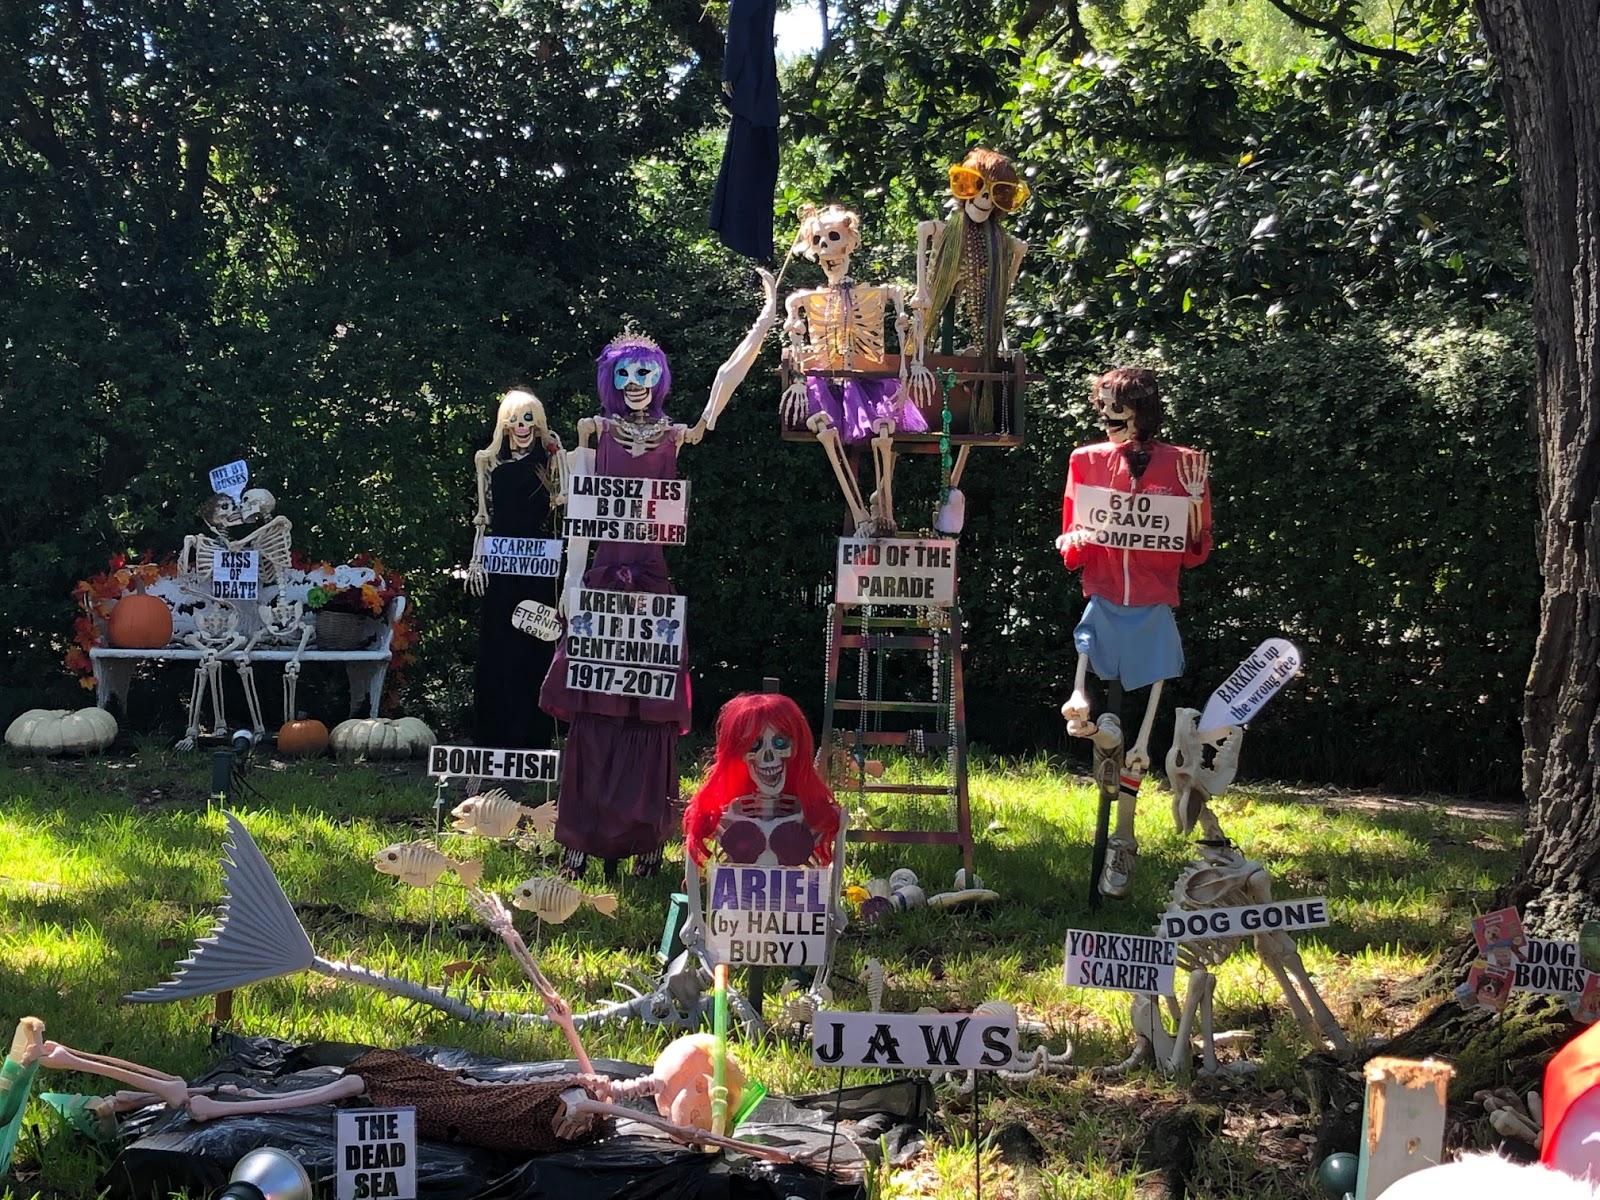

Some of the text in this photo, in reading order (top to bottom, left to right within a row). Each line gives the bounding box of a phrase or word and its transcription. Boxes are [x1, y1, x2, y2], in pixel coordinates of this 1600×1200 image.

[211, 461, 244, 480] HIT BY
[573, 476, 682, 501] LAISSEZ LES
[596, 497, 656, 519] BONE
[1109, 494, 1151, 513] 610
[563, 518, 686, 543] TEMPS ROULER
[1089, 507, 1170, 533] (GRAVE)
[221, 551, 251, 569] KISS
[490, 538, 547, 557] SCARRIE
[842, 544, 951, 568] END OF THE
[229, 568, 242, 581] OF
[480, 554, 560, 576] NDERWOOD
[213, 580, 257, 599] DEATH
[857, 575, 935, 599] PARADE
[536, 604, 551, 618] On
[579, 590, 676, 618] KREWE OF
[518, 619, 550, 640] Leave
[598, 615, 653, 640] IRIS
[566, 635, 680, 665] CENTENNIAL
[569, 663, 675, 698] 1917-2017
[1216, 645, 1279, 705] BARKING up
[1230, 656, 1297, 721] the wrong tree
[431, 747, 557, 780] BONE-FISH
[711, 868, 826, 913] ARIEL
[710, 910, 825, 937] (by HALLE
[1165, 902, 1327, 939] DOG GONE
[1068, 930, 1176, 967] YORKSHIRE
[1526, 940, 1577, 967] DOG
[1078, 960, 1159, 992] SCARIER
[1513, 963, 1585, 993] BONES
[815, 1016, 1013, 1067] JAWS
[354, 1113, 399, 1142] THE
[345, 1142, 406, 1171] DEAD
[353, 1171, 399, 1199] SEA
